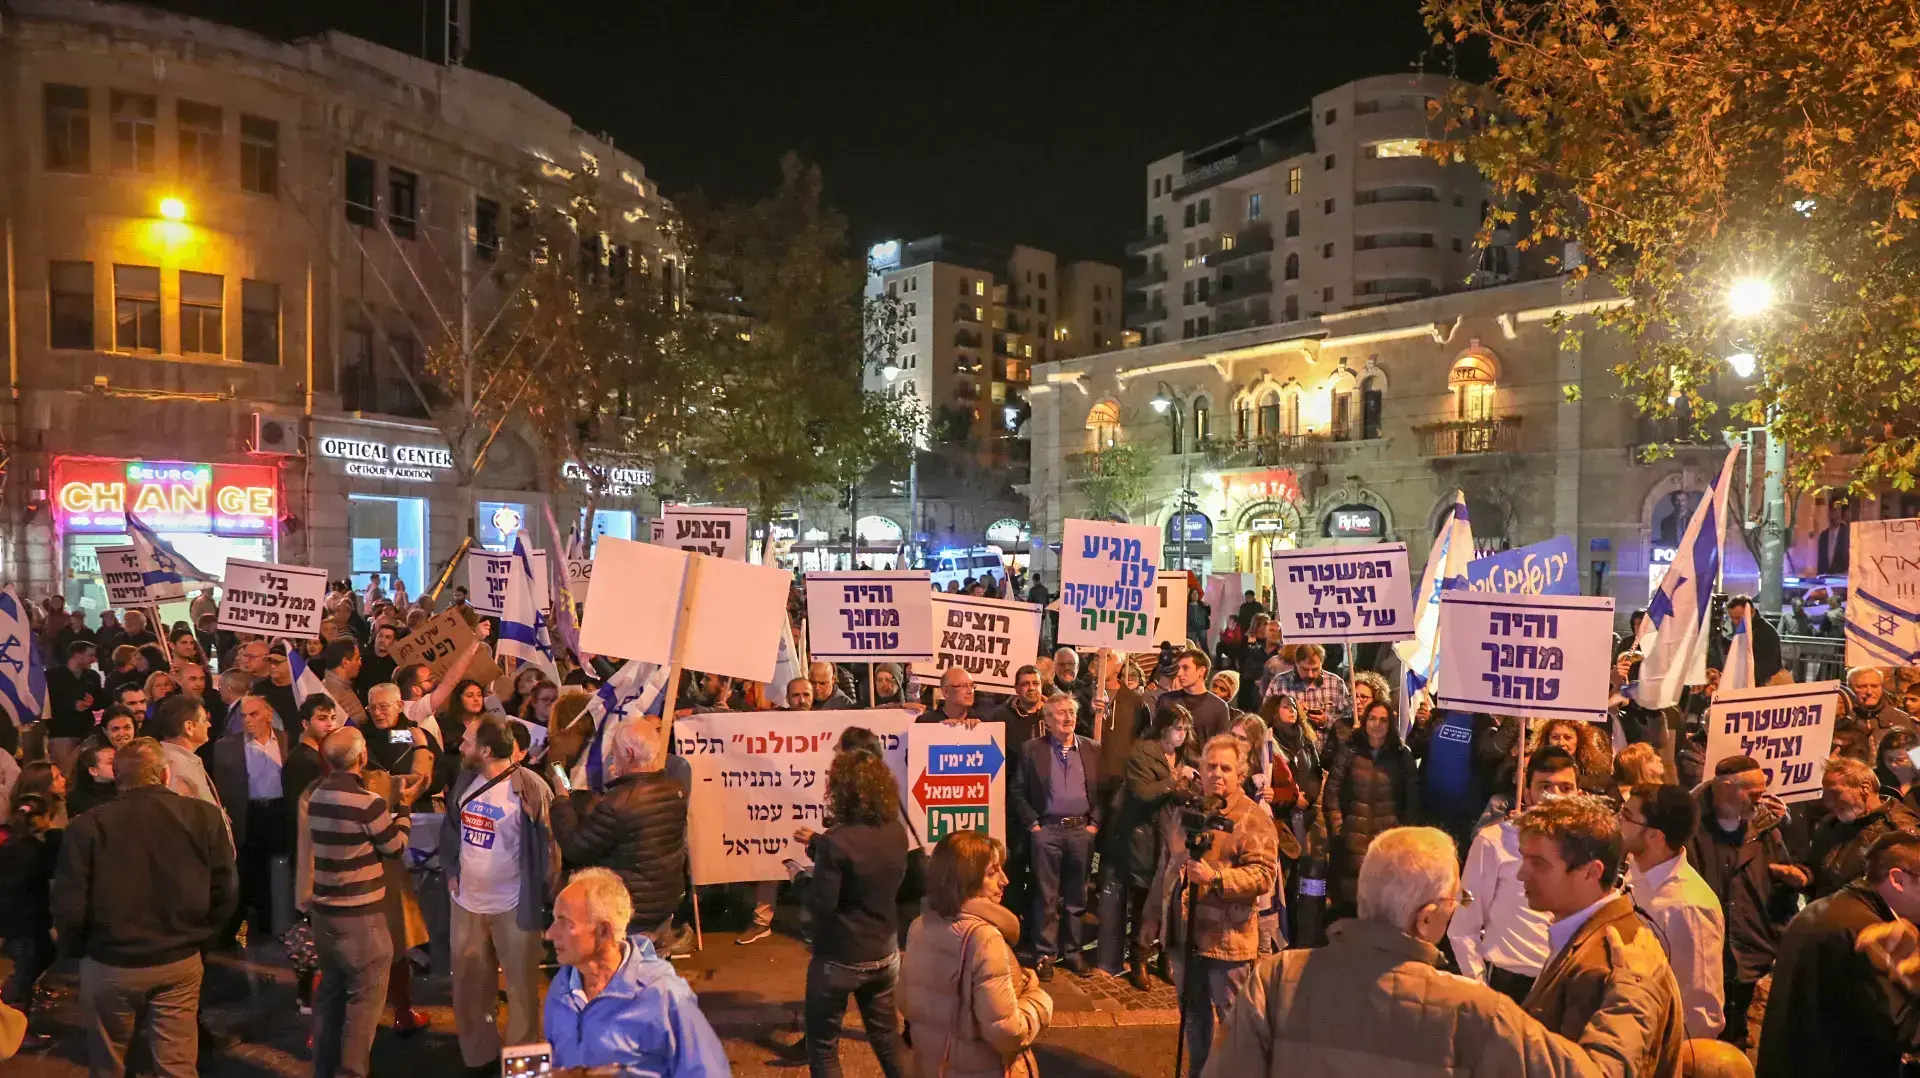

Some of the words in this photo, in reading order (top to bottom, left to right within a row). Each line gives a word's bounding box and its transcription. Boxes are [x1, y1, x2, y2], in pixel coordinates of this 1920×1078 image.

[325, 440, 389, 460] OPTICAL
[396, 448, 453, 466] CENTER
[349, 464, 387, 475] OPTIQUE
[395, 468, 433, 479] AUDITION
[61, 482, 273, 516] CHANGE
[676, 520, 731, 539] הצנע
[1338, 514, 1352, 529] Fly
[1082, 535, 1141, 563] מגיע
[487, 560, 511, 574] היה
[1120, 558, 1155, 588] לנו
[1288, 560, 1393, 583] המשטרה
[259, 572, 288, 591] בלי
[486, 577, 508, 593] חנך
[226, 588, 316, 611] ממלכתיות
[488, 594, 505, 608] הור
[843, 585, 893, 603] והיה
[1063, 581, 1143, 612] פוליטיקה
[228, 606, 280, 625] מדינה
[285, 613, 311, 629] אין
[839, 608, 900, 631] מחנך
[947, 609, 1010, 634] רוצים
[1080, 608, 1148, 640] נקייה
[1295, 607, 1352, 630] כולנו
[1356, 605, 1397, 627] של
[1489, 611, 1558, 639] והיה
[421, 637, 456, 662] רפש
[842, 632, 899, 649] טהור
[940, 630, 1011, 656] דוגמא
[936, 652, 1011, 678] אישית
[1481, 641, 1563, 673] מחנך
[1481, 672, 1560, 701] טהור
[1724, 704, 1823, 735] המשטרה
[676, 732, 724, 755] תלכו
[939, 753, 964, 771] ימין
[966, 750, 984, 767] לא
[721, 771, 782, 789] נתניהו
[790, 764, 815, 789] על
[1780, 760, 1813, 786] של
[923, 782, 964, 799] שמאל
[967, 782, 984, 798] לא
[747, 804, 783, 822] עמו
[792, 804, 826, 820] והב
[932, 810, 985, 836] ישר!
[722, 833, 789, 856] ישראל
